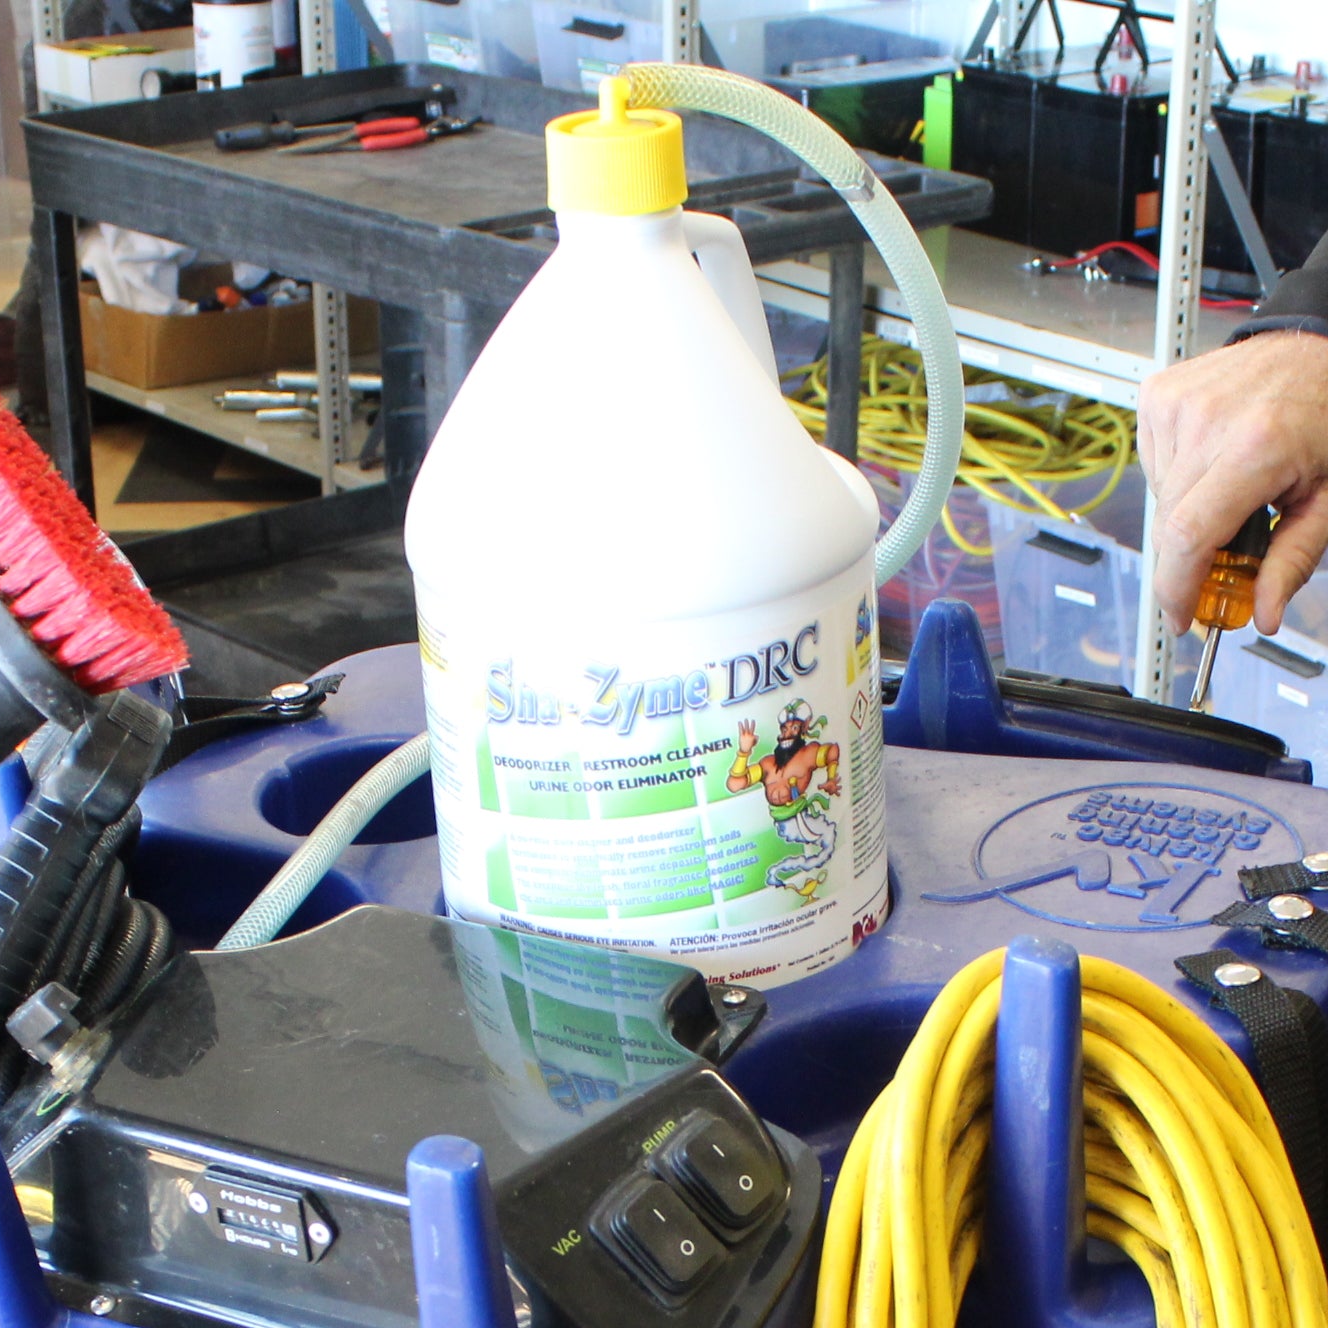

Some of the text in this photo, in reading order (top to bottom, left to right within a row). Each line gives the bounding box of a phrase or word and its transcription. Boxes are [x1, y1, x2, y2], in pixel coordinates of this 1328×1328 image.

[721, 620, 820, 707] DRC
[494, 736, 733, 773] DEODORIZER RESTROOM CLEANER
[529, 765, 707, 792] URINE ODOR ELIMINATOR
[628, 848, 667, 860] remove
[669, 838, 718, 855] restroom
[719, 829, 743, 844] soils
[638, 827, 696, 844] deodorizer
[653, 871, 703, 888] fragrance
[704, 855, 760, 877] deodorizes
[659, 856, 704, 872] deposits
[706, 850, 725, 863] and
[655, 889, 686, 903] odors
[687, 885, 707, 897] like
[537, 926, 563, 940] CAUSES
[564, 931, 596, 945] SERIOUS
[596, 936, 611, 946] EYE
[611, 937, 657, 948] IRRITATION.
[670, 932, 720, 947] ATENCIÓN:
[721, 928, 758, 942] Provoca
[758, 916, 794, 933] irritación
[794, 908, 819, 924] ocular
[640, 1119, 677, 1155] PUMP
[219, 1189, 283, 1214] Hobbs
[550, 1229, 583, 1256] VAC
